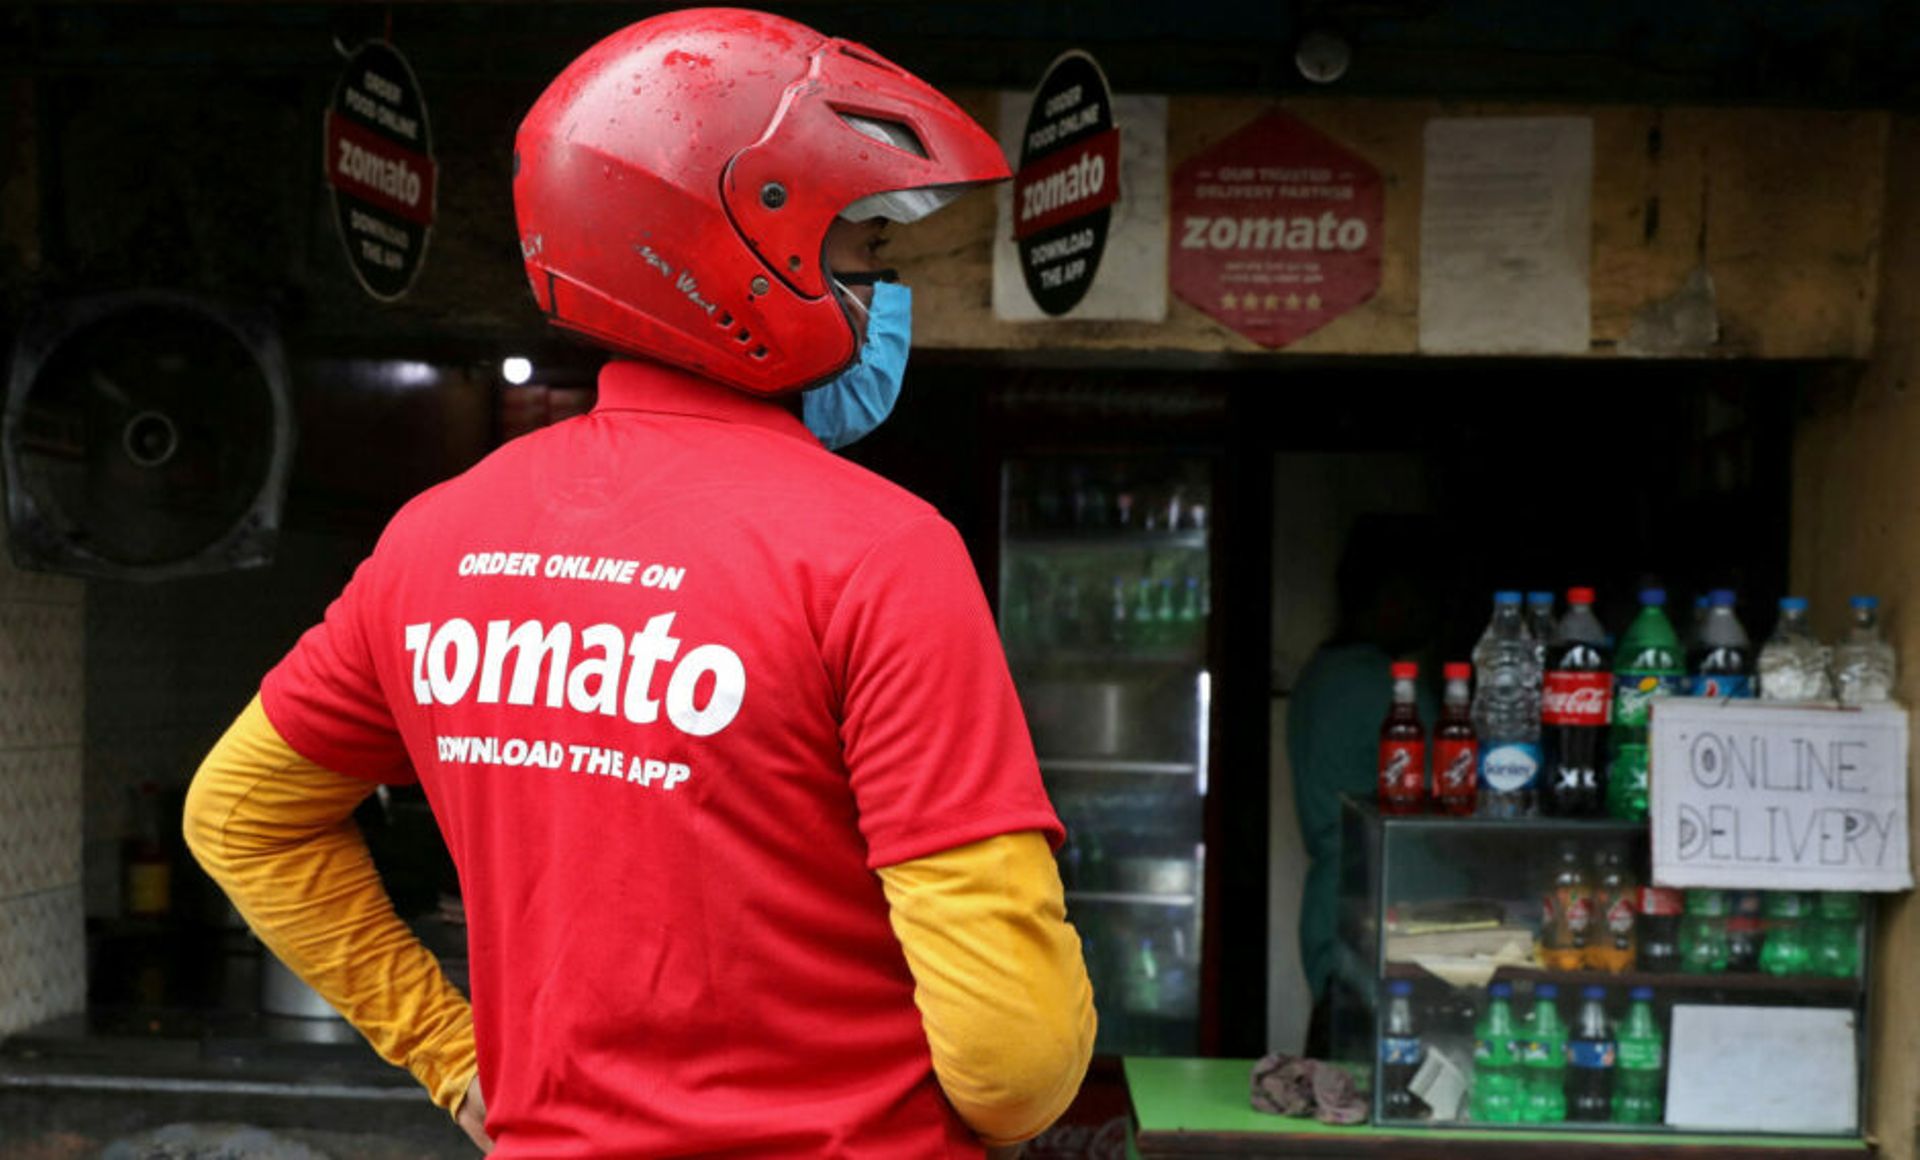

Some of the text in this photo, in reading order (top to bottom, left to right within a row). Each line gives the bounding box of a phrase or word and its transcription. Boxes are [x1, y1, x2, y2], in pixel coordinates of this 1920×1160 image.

[1059, 103, 1100, 137] ONLINE
[338, 138, 420, 206] zomato
[1021, 152, 1105, 220] zomato
[1218, 168, 1332, 182] OUR TRUSTED
[1195, 185, 1353, 199] DELIVERY PARTNER
[1030, 228, 1094, 266] DOWNLOAD
[1180, 211, 1367, 250] zomato
[1040, 258, 1086, 290] THE APP
[458, 552, 686, 591] ORDER ONLINE ON
[405, 611, 746, 737] zomato
[568, 745, 624, 779] THE
[627, 756, 691, 790] APP
[1690, 731, 1868, 793] ONLINE
[1678, 802, 1897, 866] DELIVERY
